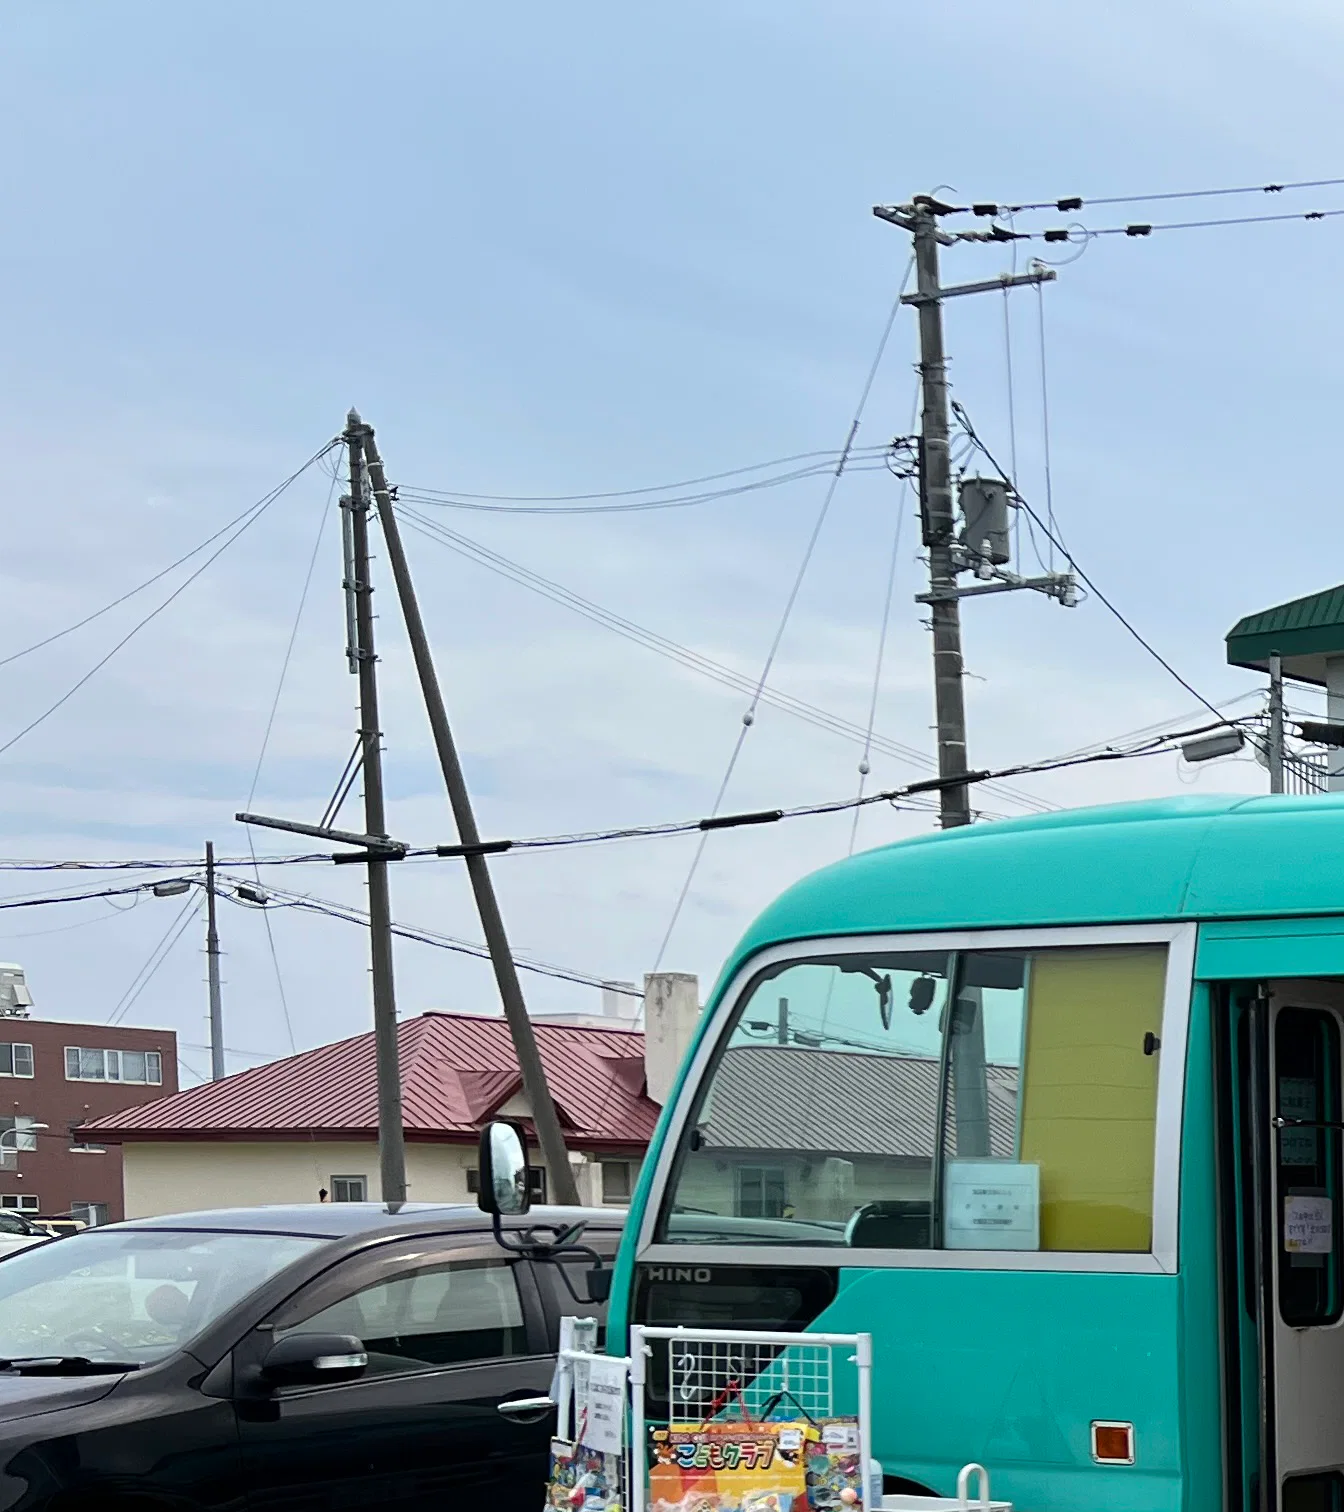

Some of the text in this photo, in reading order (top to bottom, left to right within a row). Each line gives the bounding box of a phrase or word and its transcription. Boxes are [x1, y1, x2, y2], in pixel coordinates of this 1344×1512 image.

[648, 1268, 711, 1283] HINO
[676, 1442, 776, 1470] こどもクラブ
